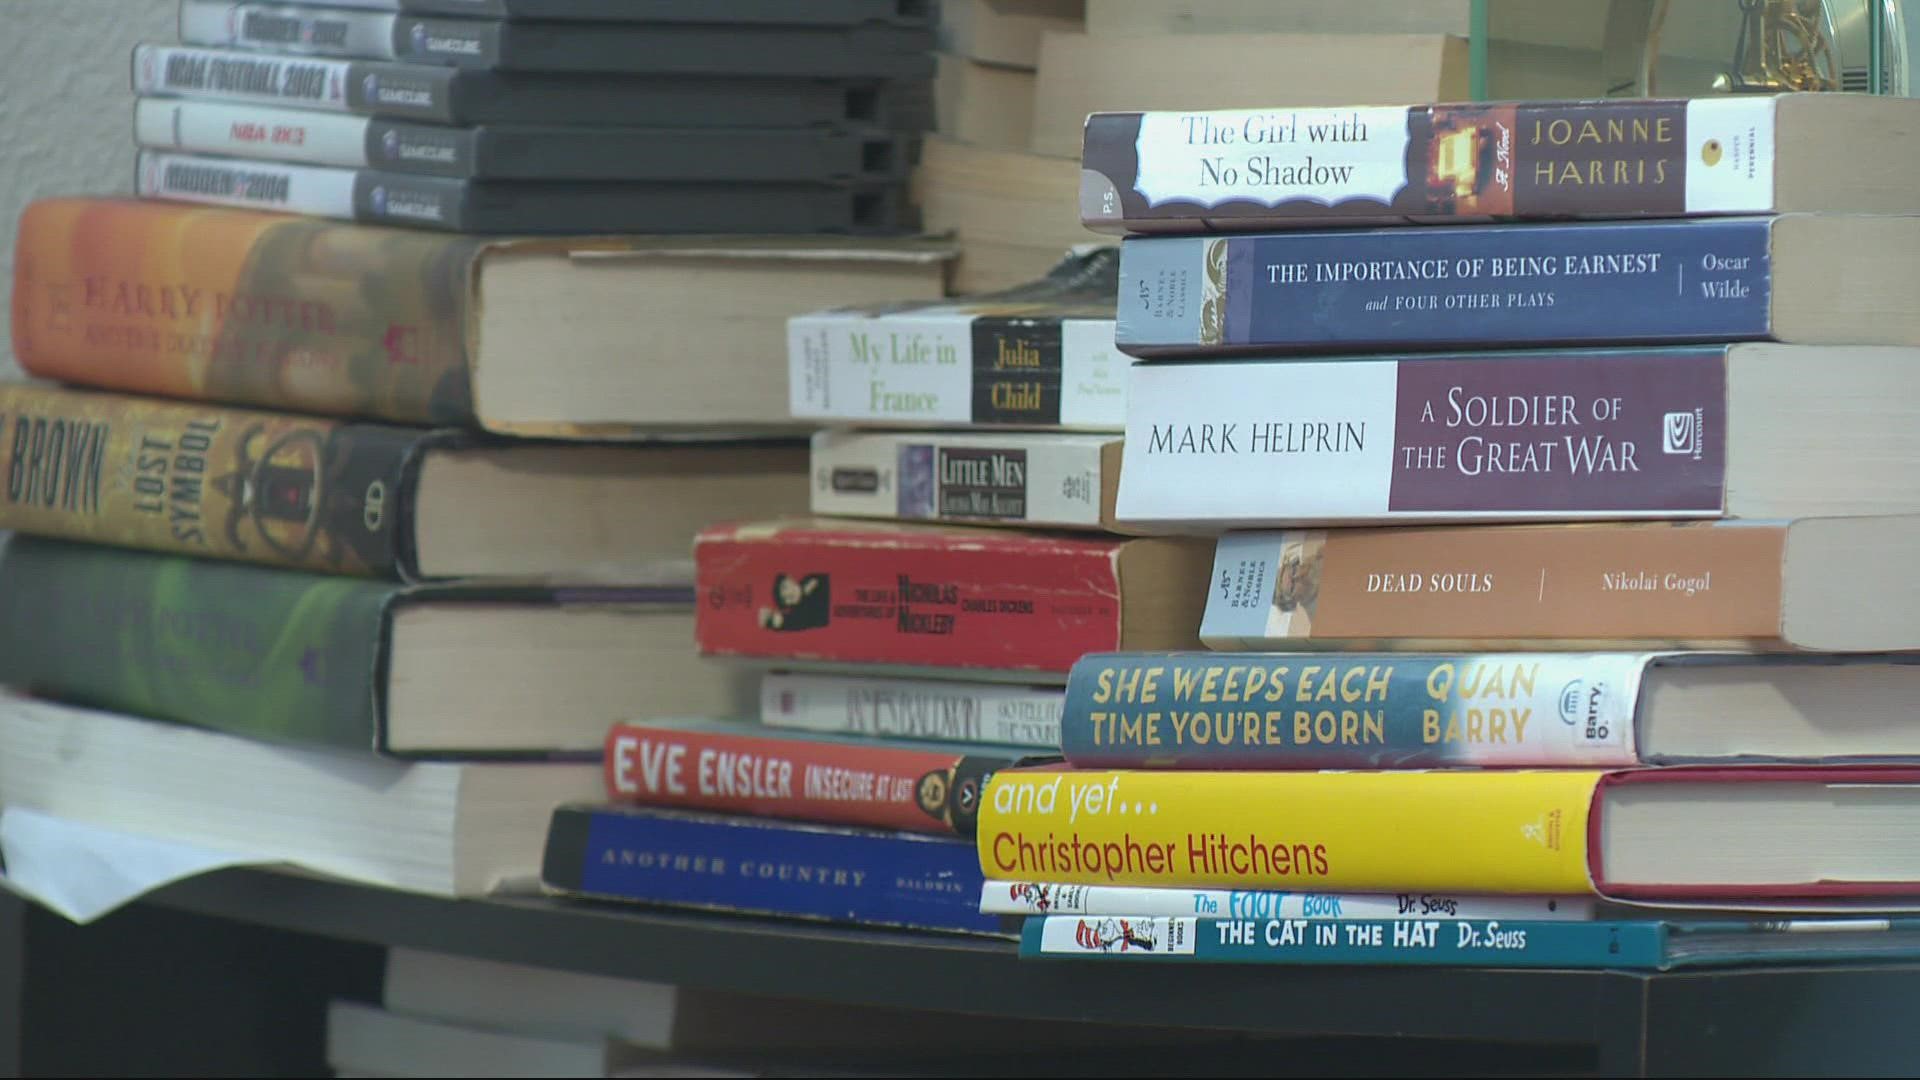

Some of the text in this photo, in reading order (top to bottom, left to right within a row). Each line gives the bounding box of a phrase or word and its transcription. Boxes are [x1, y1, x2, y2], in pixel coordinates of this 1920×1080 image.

[1181, 113, 1368, 145] The Girl with
[1532, 118, 1673, 145] JOANNE
[1200, 156, 1355, 187] No Shadow
[1534, 159, 1668, 186] HARRIS
[1267, 252, 1661, 284] THE IMPORTANCE OF BEING EARNEST
[1702, 253, 1751, 271] Oscar
[1365, 292, 1555, 312] and FOUR OTHER PLAYS
[1702, 280, 1750, 299] Wilde
[889, 332, 932, 364] Life
[936, 334, 958, 364] in
[993, 338, 1041, 369] Julia
[869, 379, 939, 412] France
[991, 382, 1042, 410] Child
[1420, 387, 1623, 428] A SOLDIER OF
[1148, 421, 1366, 455] MARK HELPRIN
[1692, 407, 1705, 461] Harcourt
[9, 415, 109, 515] BROWN
[1401, 434, 1641, 476] THE GREAT WAR
[134, 435, 173, 514] LOST
[170, 418, 224, 543] SYMBOL
[1231, 560, 1247, 608] BARNES
[1243, 560, 1257, 598] NOBLE
[1250, 560, 1266, 608] CLASSICS
[1367, 573, 1494, 593] DEAD SOULS
[1601, 571, 1712, 597] Nikolai Gogol
[1093, 666, 1395, 704] SHE WEEPS EACH
[1426, 663, 1541, 704] QUAN
[1090, 711, 1162, 746] TIME
[1170, 711, 1282, 745] YOU'RE
[1293, 710, 1385, 745] BORN
[1423, 708, 1533, 745] BARRY
[613, 736, 687, 794] EVE
[699, 749, 793, 799] ENSLER
[804, 764, 875, 801] INSECURE
[876, 776, 890, 801] AT
[994, 775, 1063, 815] and
[601, 848, 867, 888] ANOTHER COUNTRY
[993, 831, 1330, 881] Christopher Hitchens
[896, 876, 964, 894] BALDWIN
[1193, 893, 1218, 914] The
[1229, 890, 1291, 918] FOOT
[1396, 894, 1458, 916] Dr. Seuss
[1216, 920, 1440, 948] THE CAT IN THE HAT
[1457, 922, 1526, 950] Dr. Seuss
